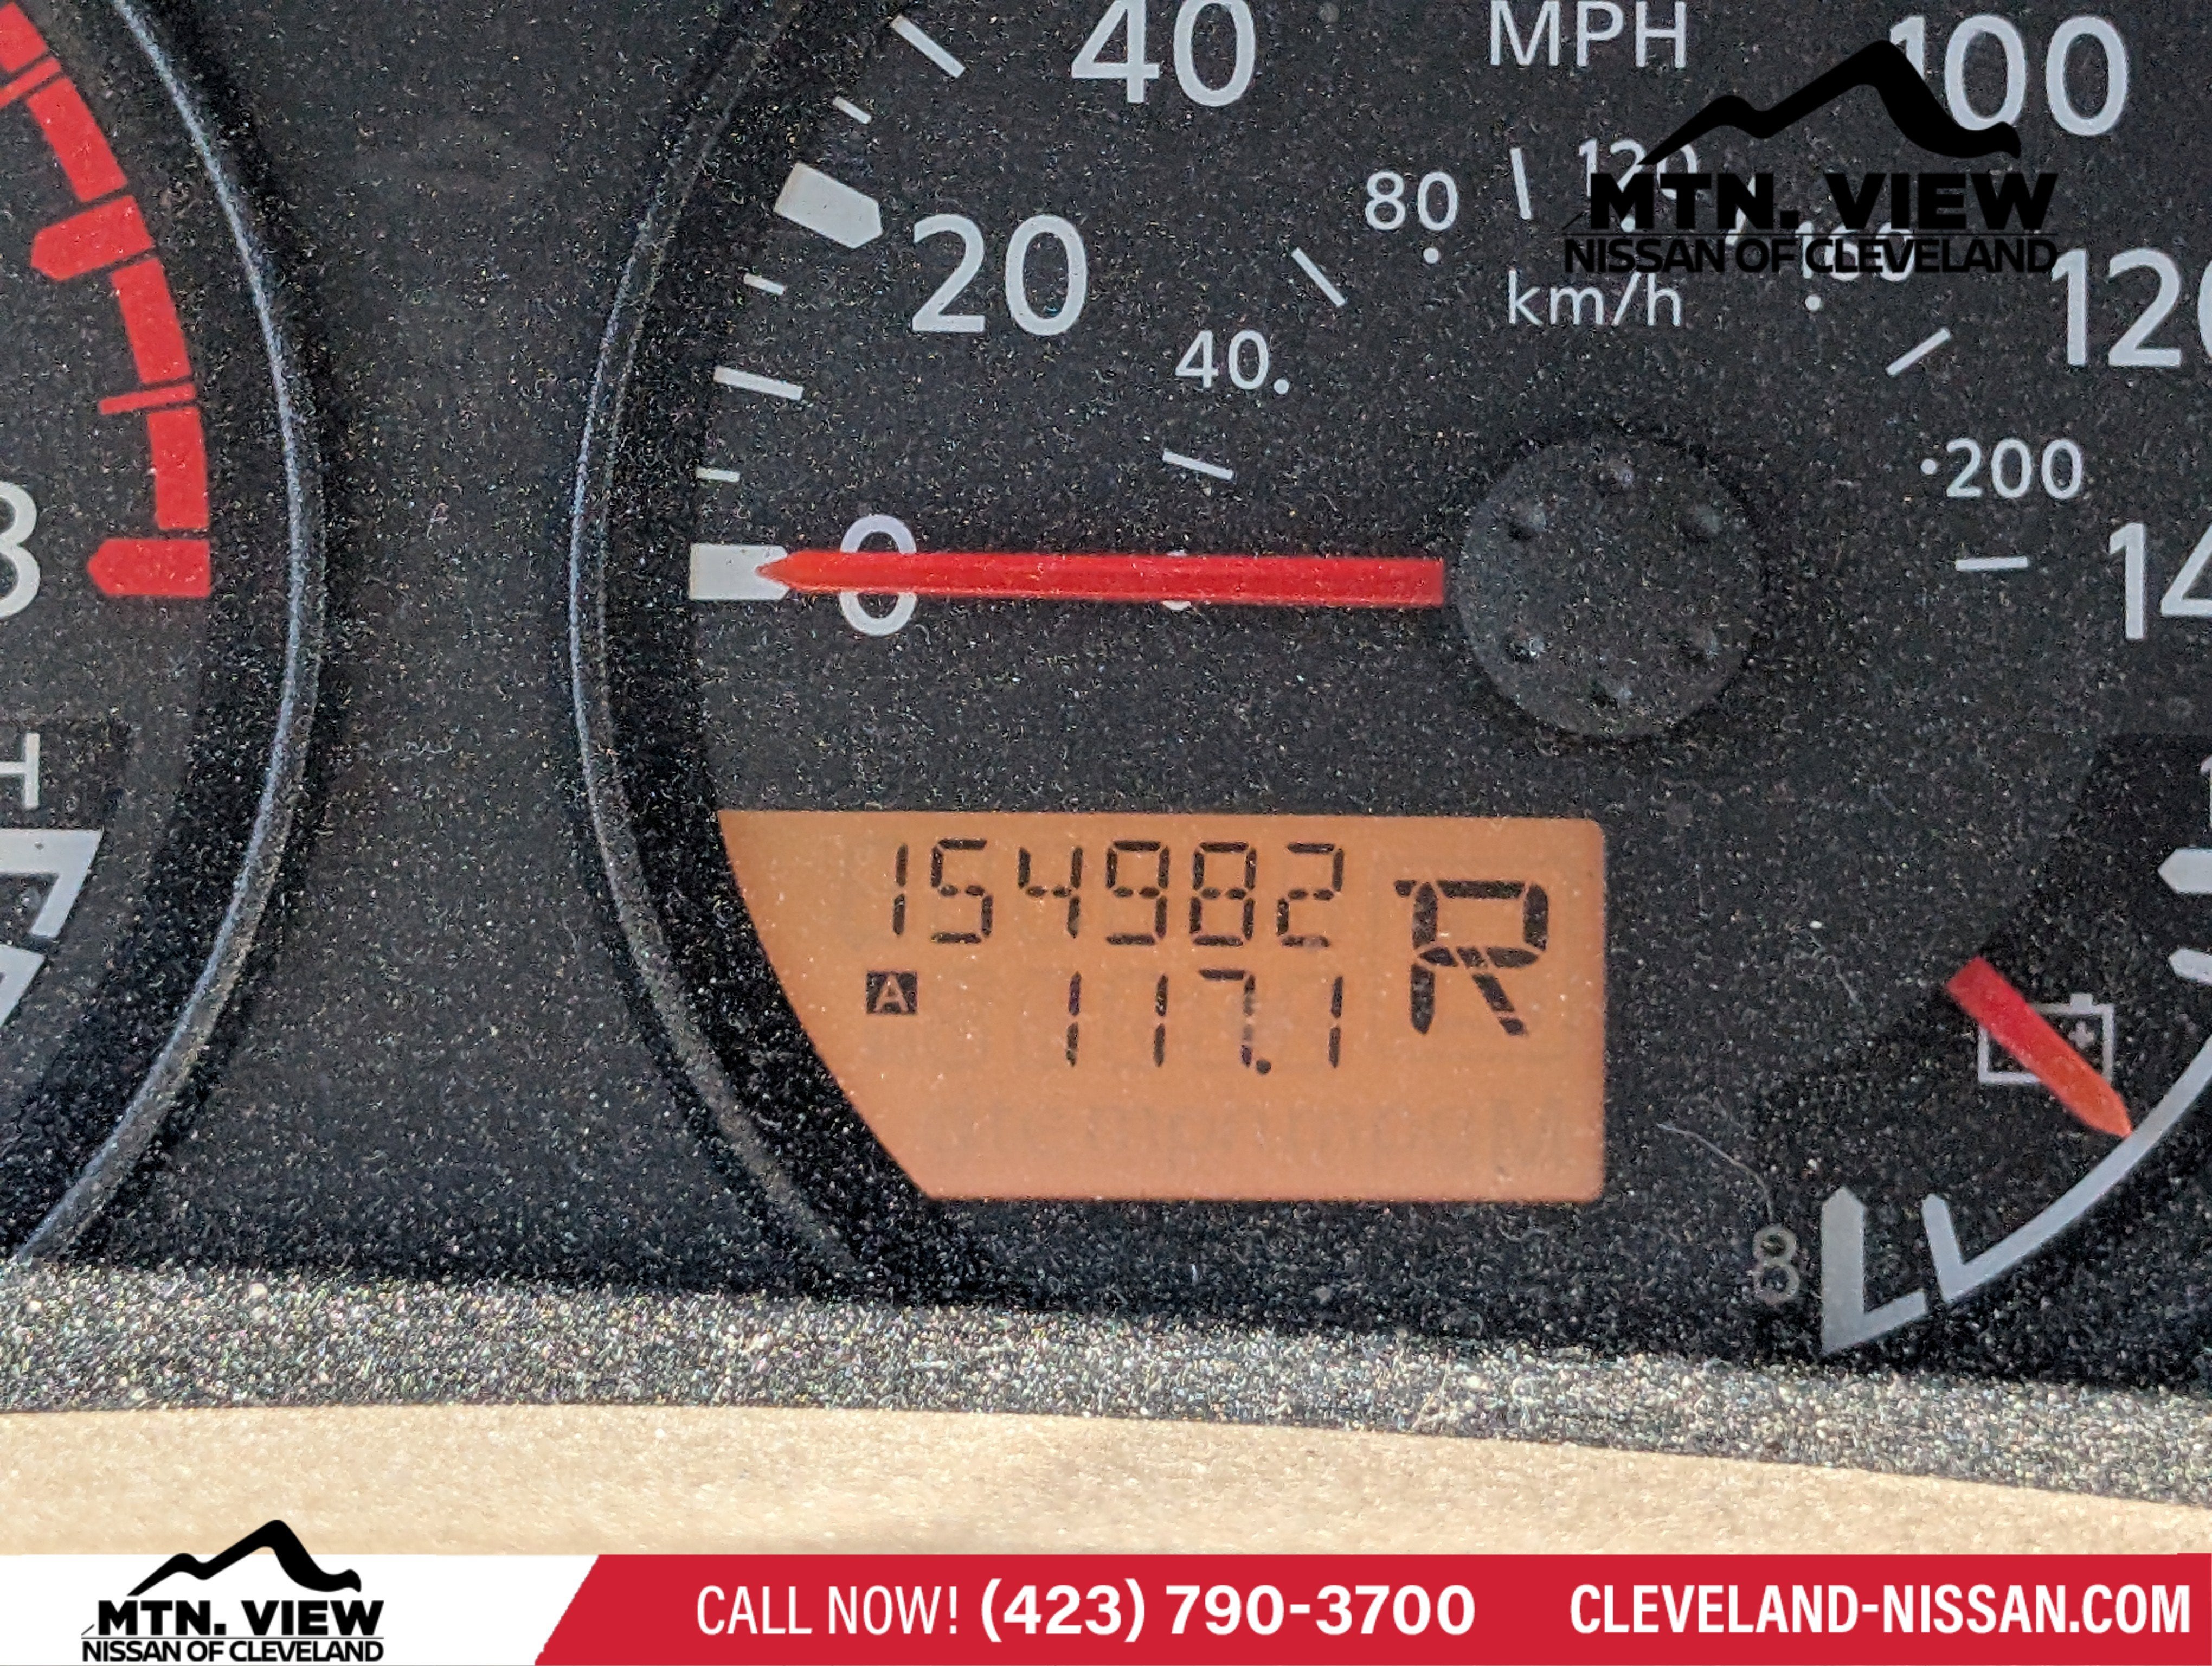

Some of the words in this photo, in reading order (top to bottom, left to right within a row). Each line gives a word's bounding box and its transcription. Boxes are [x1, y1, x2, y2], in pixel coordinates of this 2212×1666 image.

[1071, 0, 1256, 107] 40
[1490, 0, 1687, 68] MPH
[1365, 171, 1458, 231] 80
[912, 213, 1088, 336] 20
[1508, 270, 1681, 327] km/h
[2052, 248, 2212, 367] 12
[1175, 330, 1270, 390] 40
[1946, 438, 2084, 500] 200
[840, 513, 917, 636] 0
[893, 838, 1343, 946] 154982
[869, 972, 915, 1014] A
[1395, 880, 1548, 1035] R
[1064, 969, 1343, 1074] 117.1
[1753, 1224, 1800, 1303] 8
